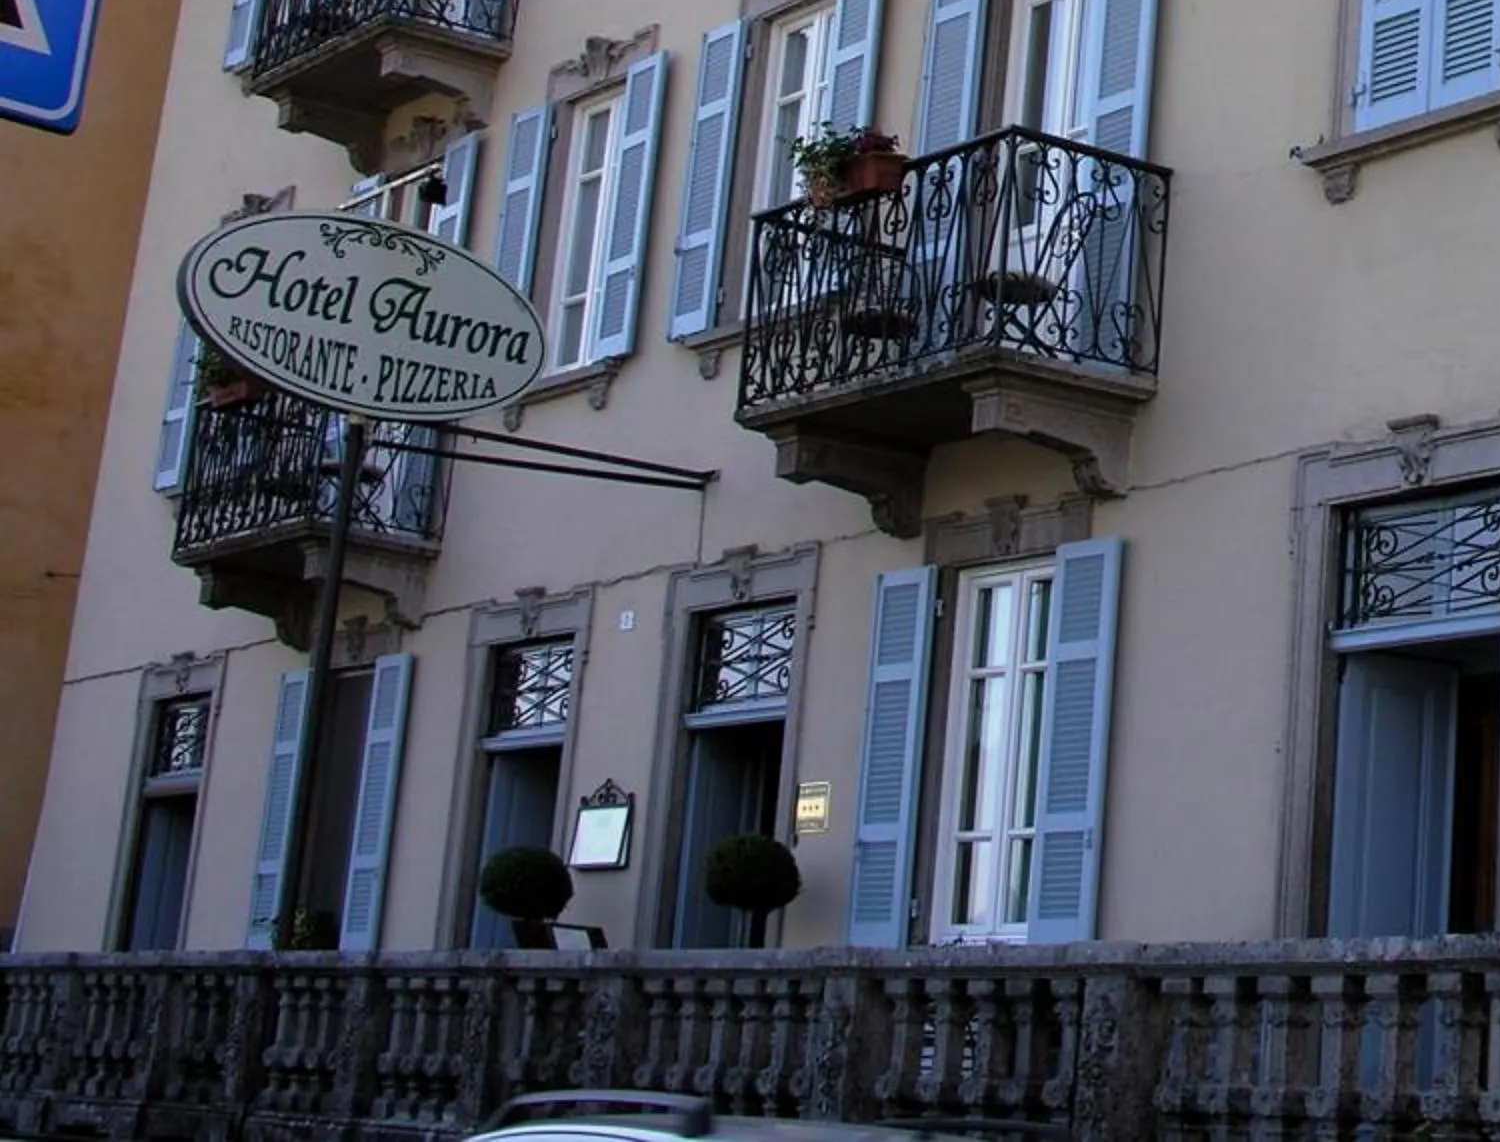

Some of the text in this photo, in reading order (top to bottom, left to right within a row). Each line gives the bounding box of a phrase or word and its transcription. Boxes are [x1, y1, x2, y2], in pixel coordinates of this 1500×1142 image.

[209, 247, 531, 364] Hotel Aurora
[228, 315, 497, 404] RISTORANTE PIZZERIA
